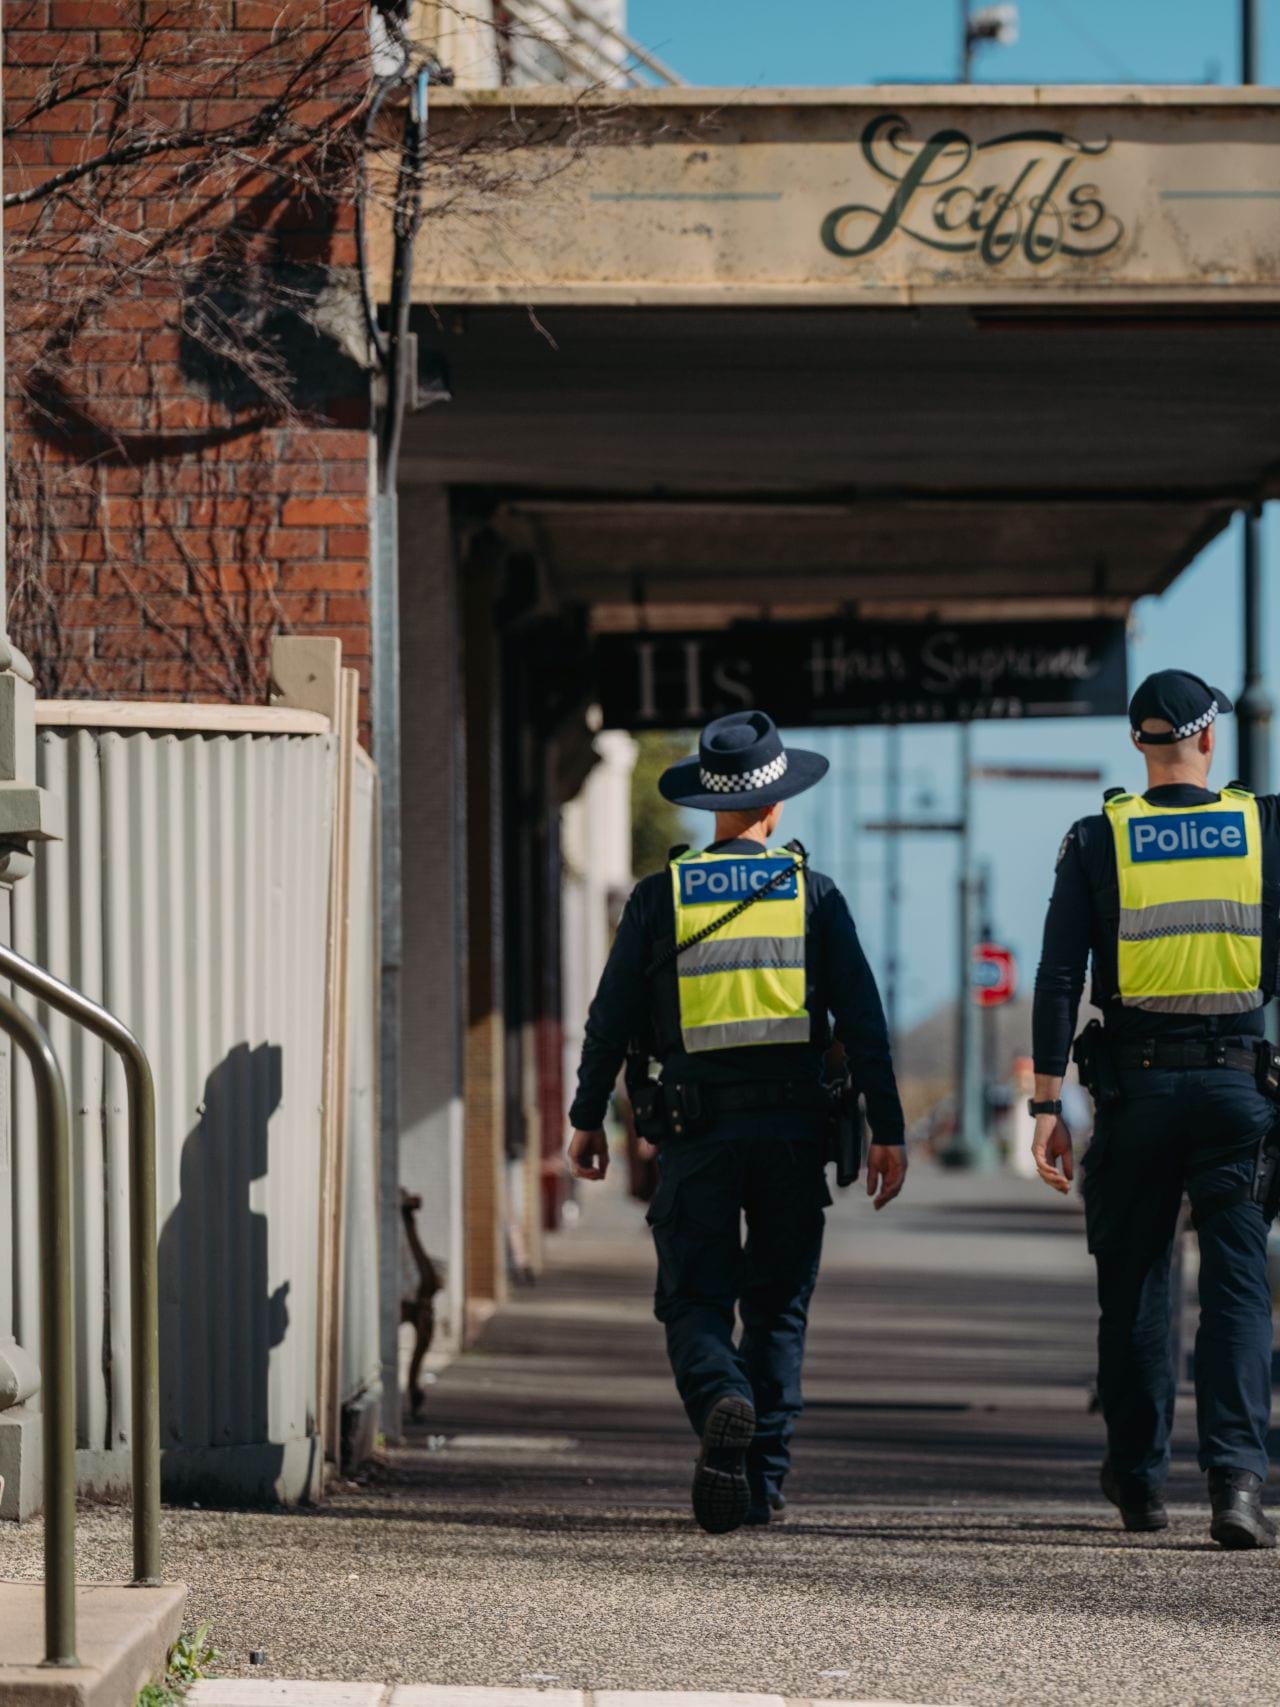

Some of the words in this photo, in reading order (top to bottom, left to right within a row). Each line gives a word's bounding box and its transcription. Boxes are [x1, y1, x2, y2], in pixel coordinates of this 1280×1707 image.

[920, 630, 1099, 694] Supreme
[1134, 821, 1241, 853] Police
[684, 865, 792, 896] Police
